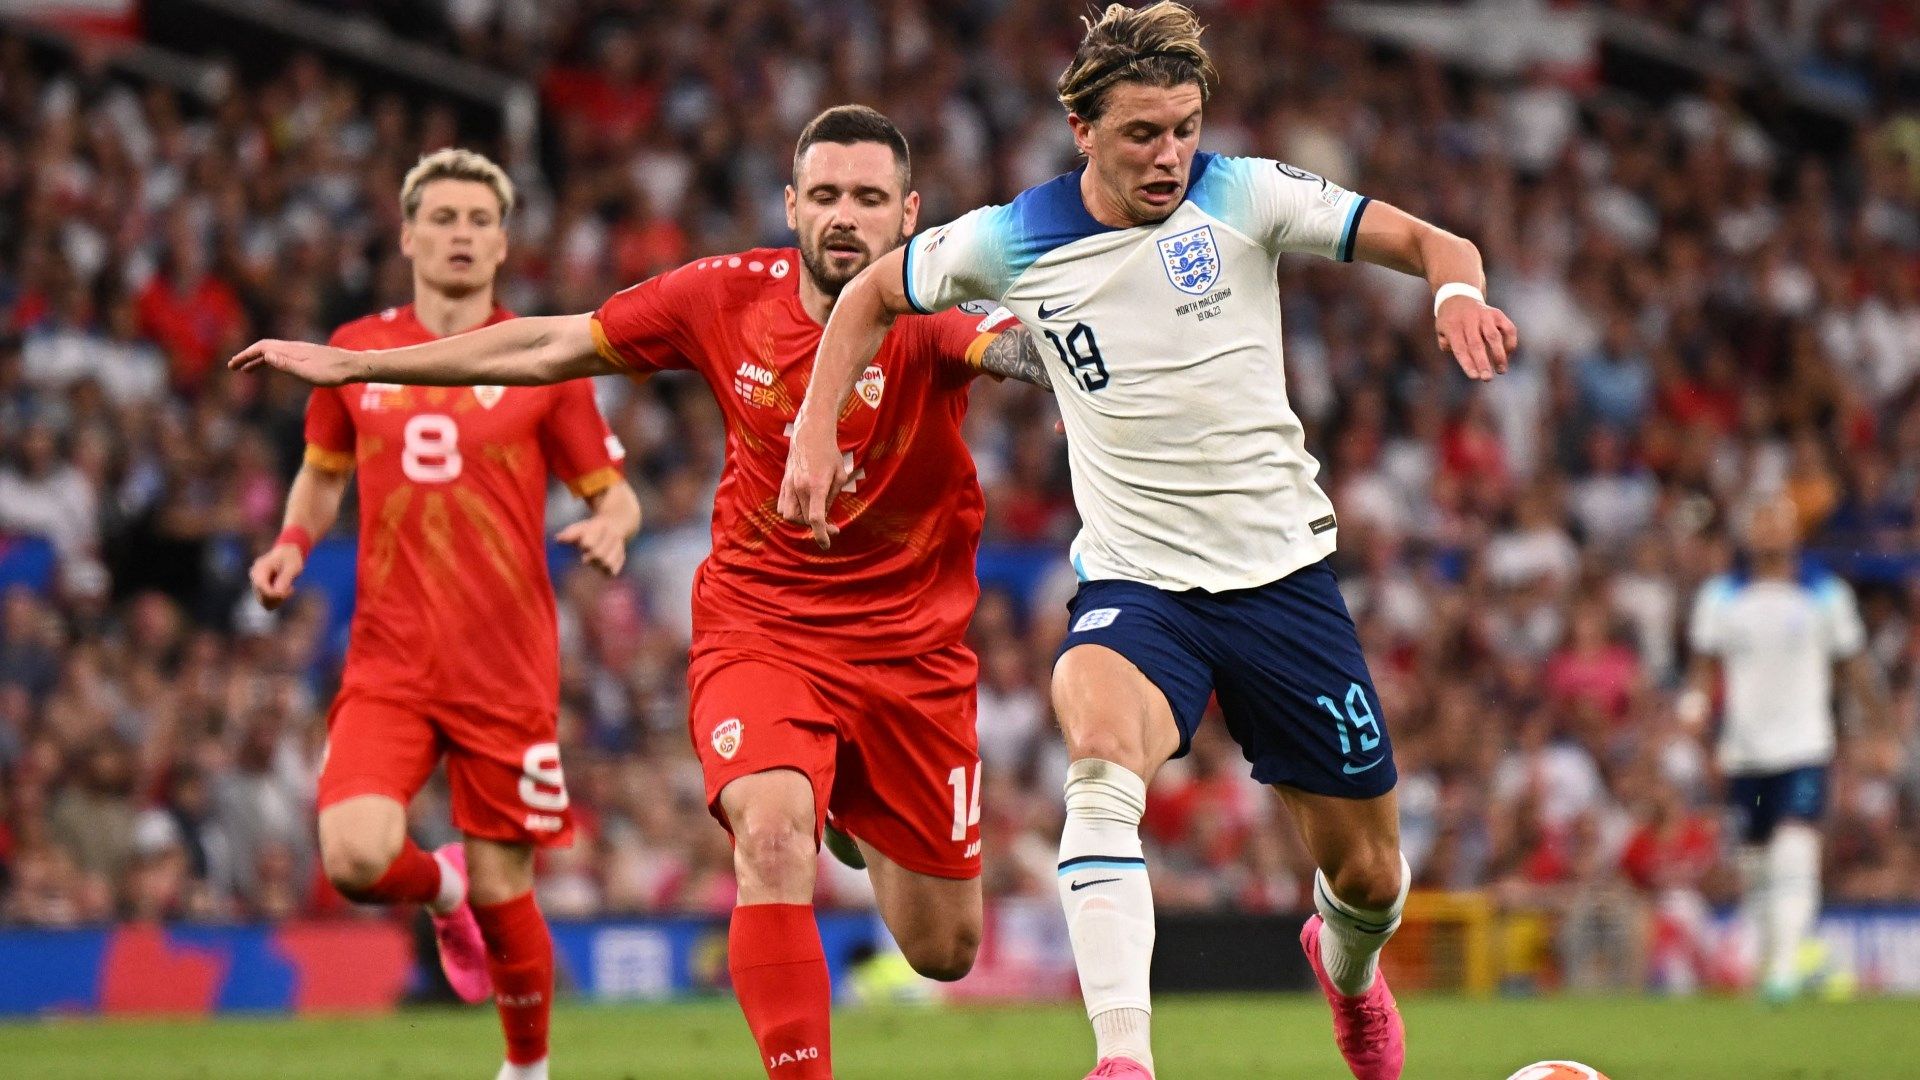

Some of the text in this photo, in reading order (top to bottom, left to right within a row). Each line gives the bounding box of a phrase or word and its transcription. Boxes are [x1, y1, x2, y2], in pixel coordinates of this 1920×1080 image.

[1175, 287, 1232, 316] NORTH MACEDONIA
[736, 361, 773, 386] JAKO
[1044, 322, 1110, 392] 19
[402, 414, 462, 482] 8
[1317, 682, 1380, 754] 19
[518, 742, 570, 811] 8
[770, 1046, 818, 1069] JAKO
